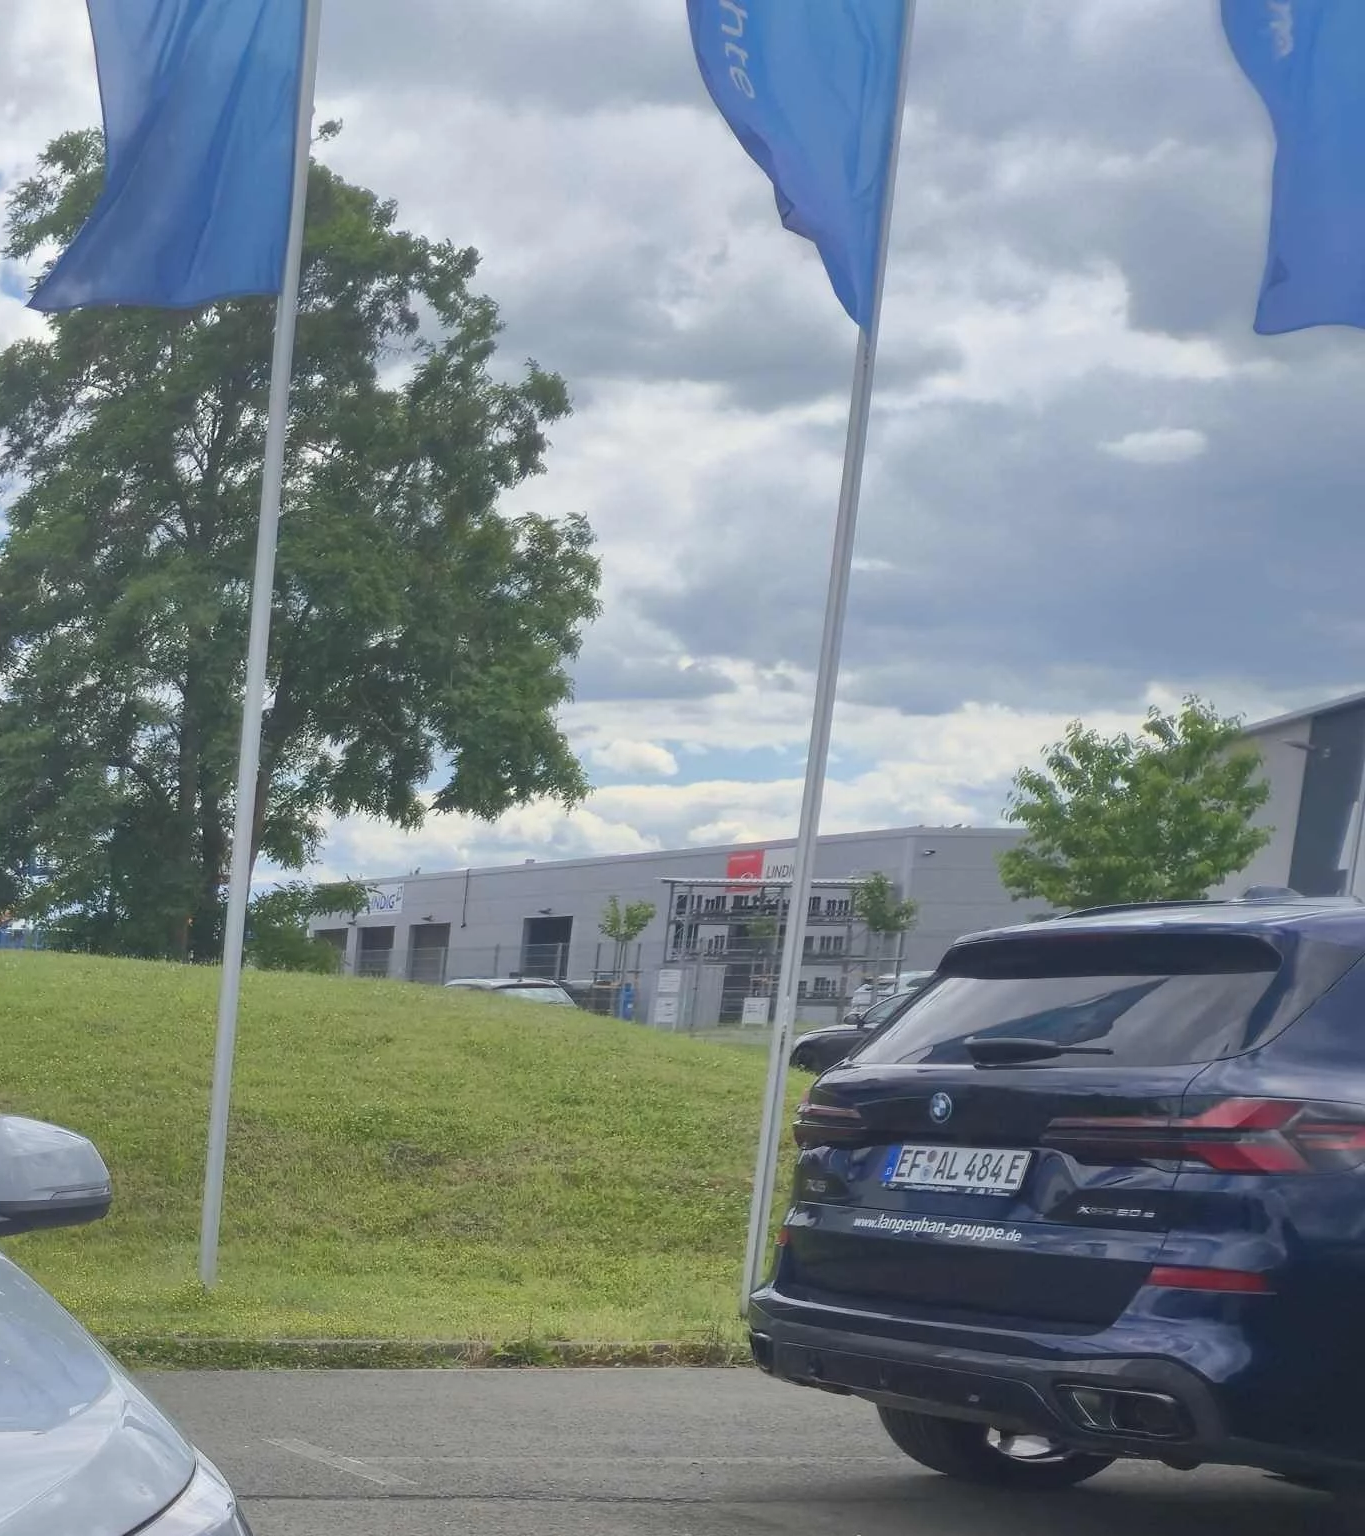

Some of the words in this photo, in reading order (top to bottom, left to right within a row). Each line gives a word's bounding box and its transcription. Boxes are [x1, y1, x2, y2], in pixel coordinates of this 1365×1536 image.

[895, 1149, 927, 1178] EF
[933, 1151, 959, 1181] AL
[852, 1213, 1022, 1242] www.langenhan-gruppe.de
